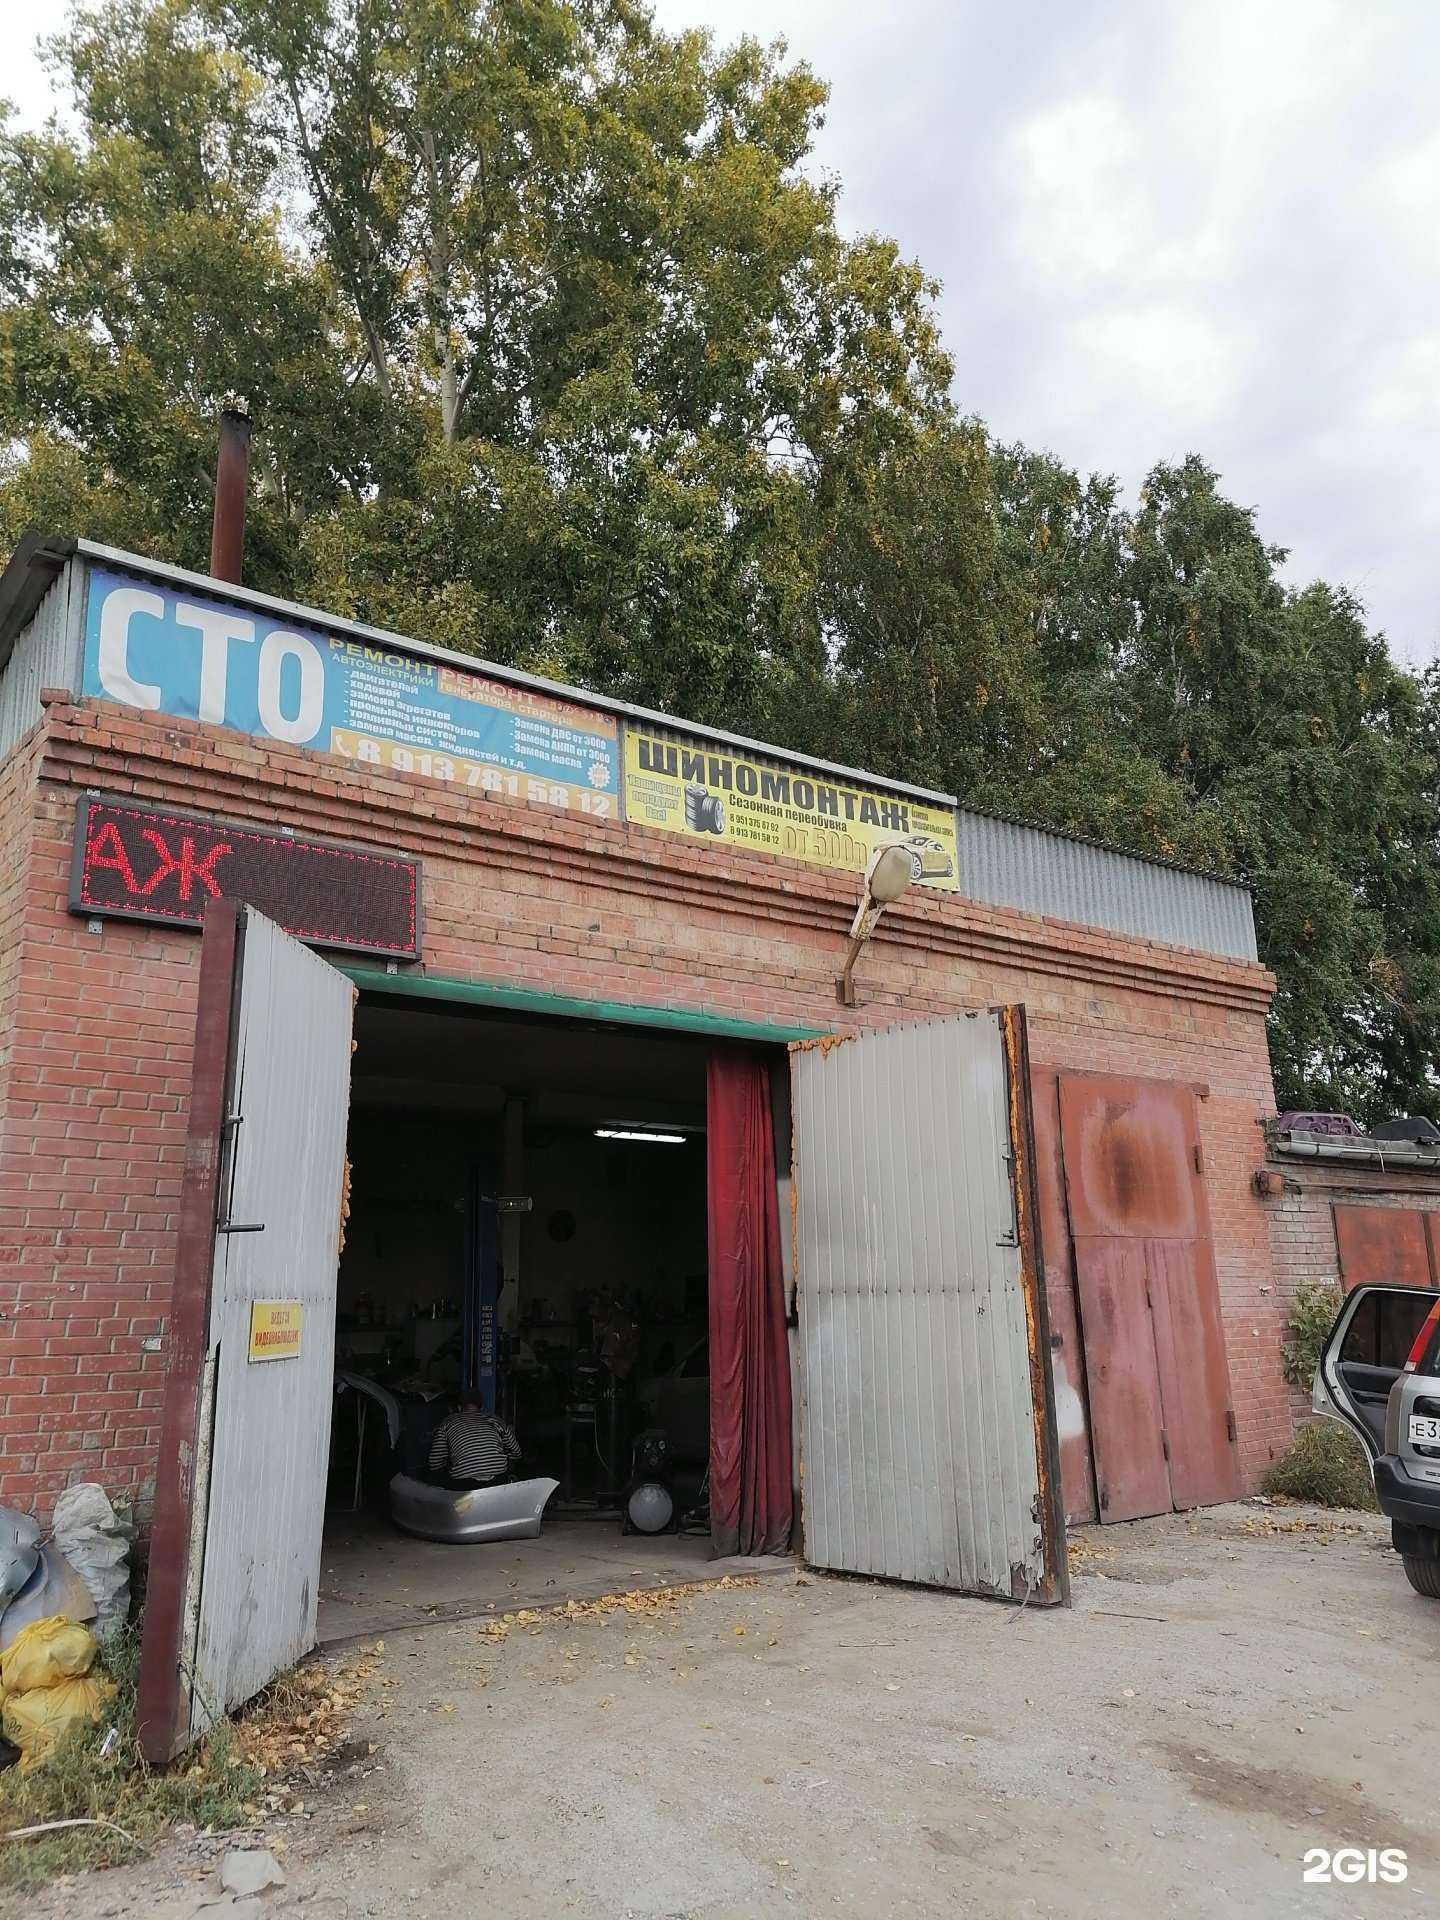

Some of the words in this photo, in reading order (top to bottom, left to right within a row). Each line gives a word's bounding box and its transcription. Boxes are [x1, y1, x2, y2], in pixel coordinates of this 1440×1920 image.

[98, 588, 325, 743] СТО
[329, 638, 437, 676] РЕМОНТ
[332, 653, 434, 687] АВТОЭЛЕКТРИКИ
[441, 668, 538, 705] РЕМОНТ
[416, 726, 457, 743] систем
[357, 739, 381, 764] 8
[391, 747, 455, 781] 913
[463, 763, 520, 797] 781
[527, 778, 570, 808] 58
[577, 791, 611, 819] 12
[638, 738, 910, 833] ШИНОМОНТАЖ
[729, 793, 783, 818] Сезонная
[785, 807, 847, 833] переобувка
[736, 827, 748, 838] 913
